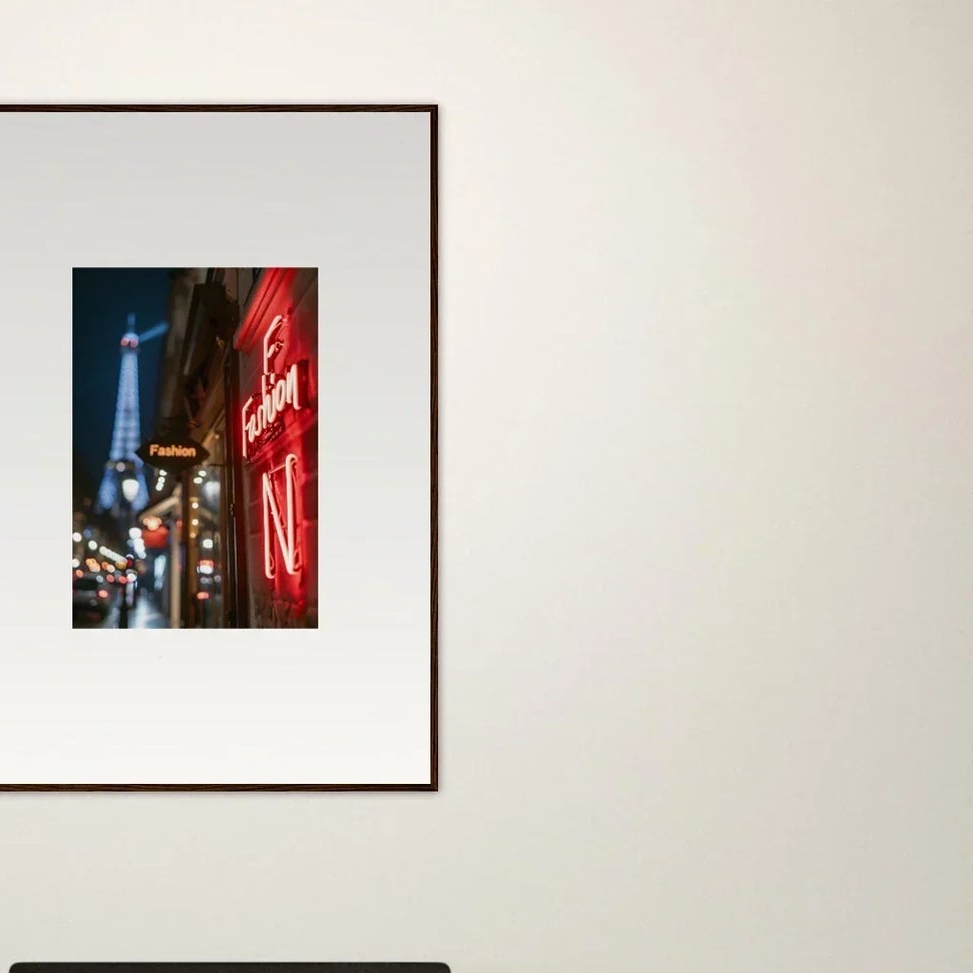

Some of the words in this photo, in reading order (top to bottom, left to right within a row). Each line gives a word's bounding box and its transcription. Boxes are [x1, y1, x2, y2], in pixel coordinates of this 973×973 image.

[149, 444, 196, 458] Fashion
[241, 363, 302, 459] Fashion
[262, 453, 301, 580] N
